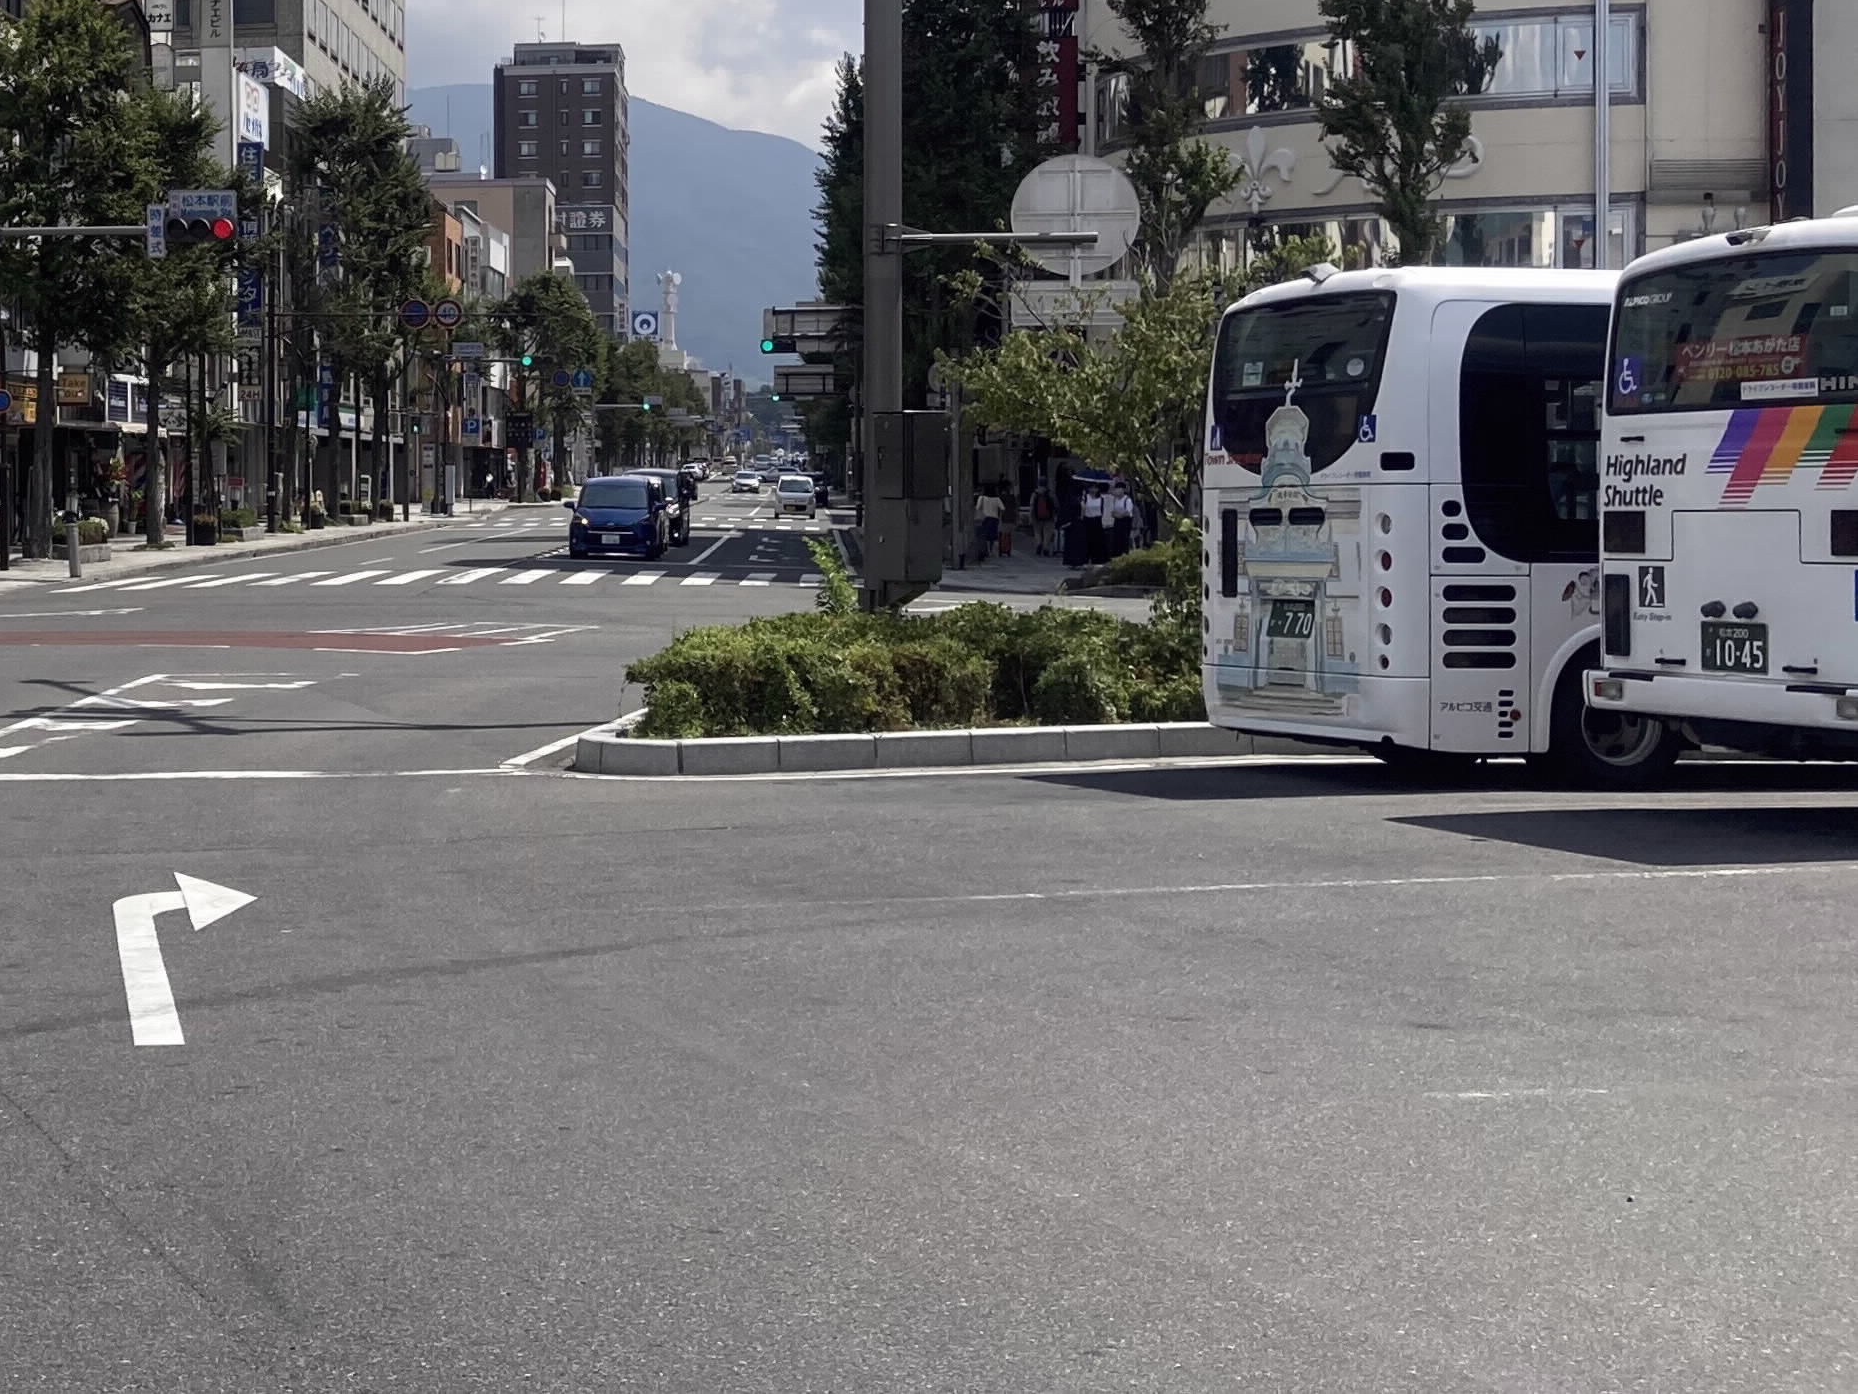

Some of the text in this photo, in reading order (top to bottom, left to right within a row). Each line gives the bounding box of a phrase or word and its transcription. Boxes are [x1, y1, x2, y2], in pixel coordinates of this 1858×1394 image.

[147, 13, 172, 23] カナエ
[182, 194, 233, 207] 松本駅前
[1681, 336, 1802, 358] ベンリー松本あがた店
[61, 377, 86, 388] Take
[467, 419, 477, 431] P
[1605, 453, 1687, 482] Highland
[1604, 484, 1664, 507] Shuttle
[1715, 638, 1763, 668] 10-45
[1440, 700, 1494, 713] アルピコ交通
